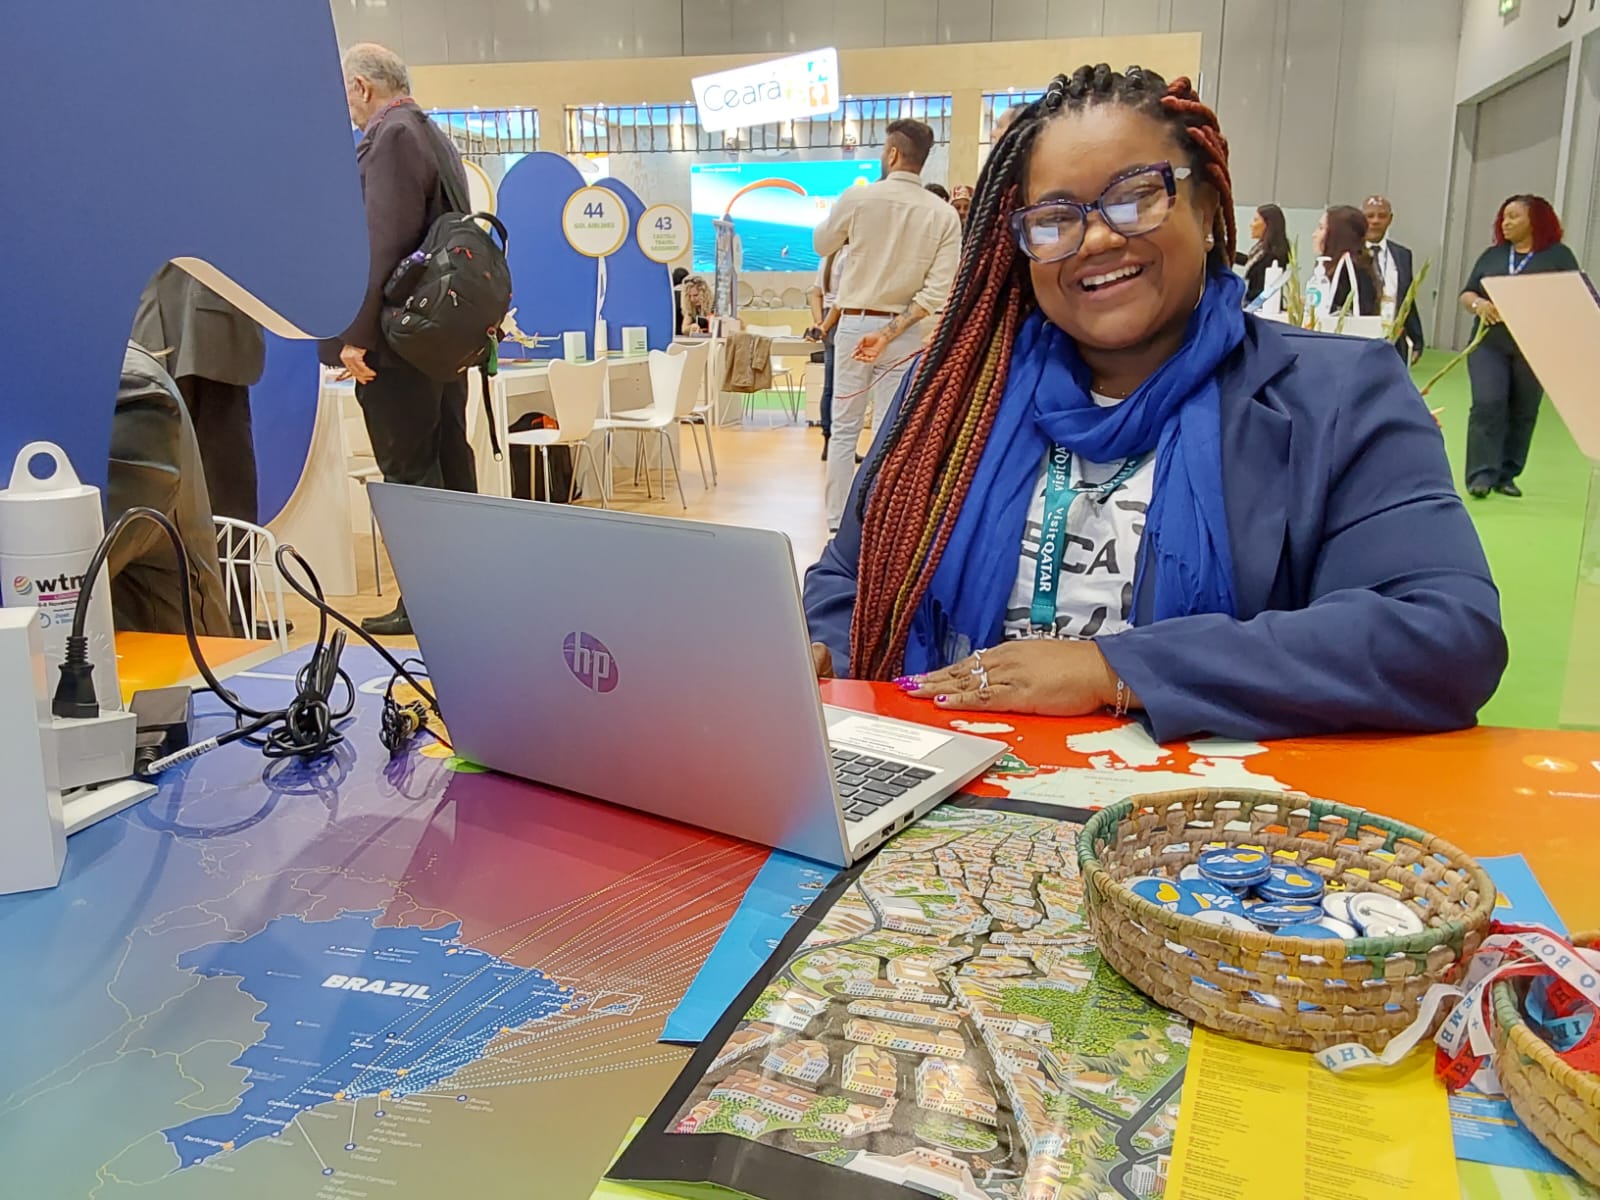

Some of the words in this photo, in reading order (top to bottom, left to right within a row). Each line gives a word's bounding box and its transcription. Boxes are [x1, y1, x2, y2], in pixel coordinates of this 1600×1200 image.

[702, 72, 782, 112] Ceará
[583, 202, 604, 218] 44
[654, 216, 673, 230] 43
[1039, 507, 1064, 592] visitQATAR
[573, 631, 610, 692] hp
[321, 974, 431, 1000] BRAZIL
